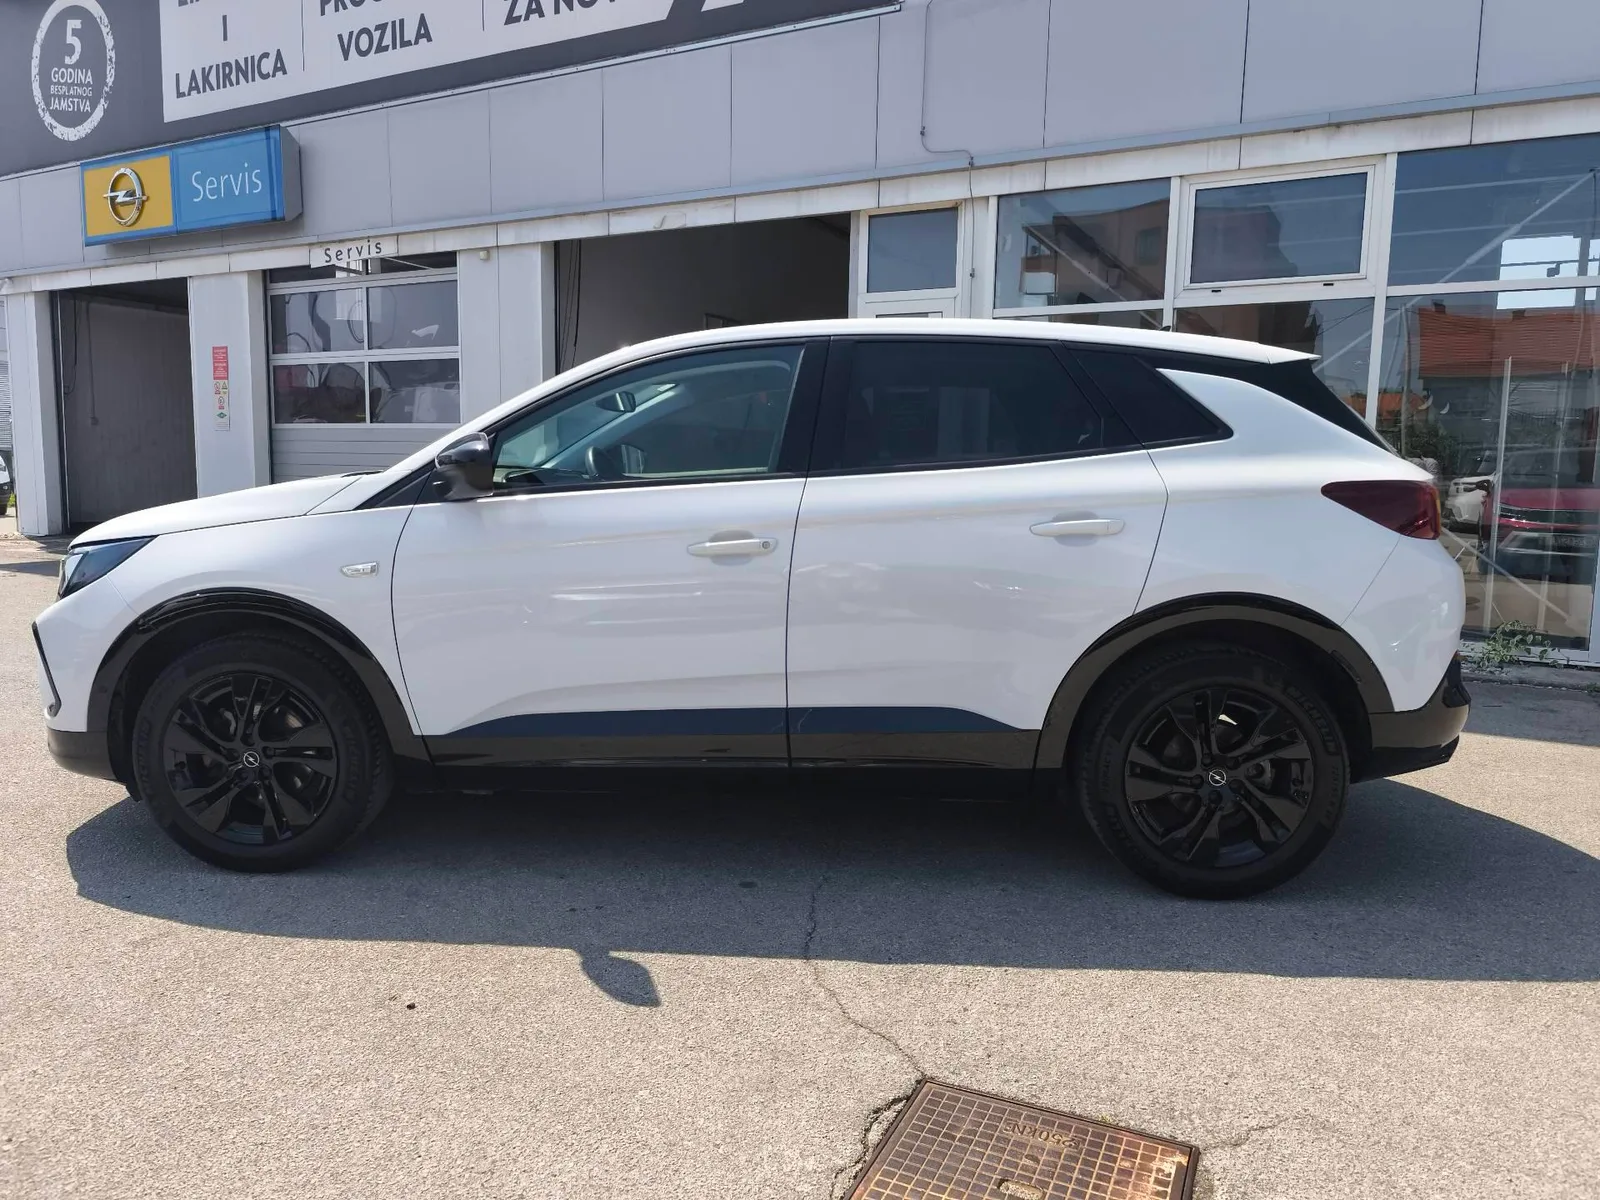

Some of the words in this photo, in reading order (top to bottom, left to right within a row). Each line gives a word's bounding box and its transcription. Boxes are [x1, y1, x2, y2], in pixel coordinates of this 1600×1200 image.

[222, 15, 228, 42] I
[337, 13, 433, 61] VOZILA
[65, 20, 82, 65] 5
[51, 67, 93, 85] GODINA
[175, 49, 288, 99] LAKIRNICA
[50, 85, 93, 97] BESPLATNOG
[49, 97, 91, 113] JAMSTVA
[191, 162, 262, 202] Servis
[324, 239, 382, 263] Servis
